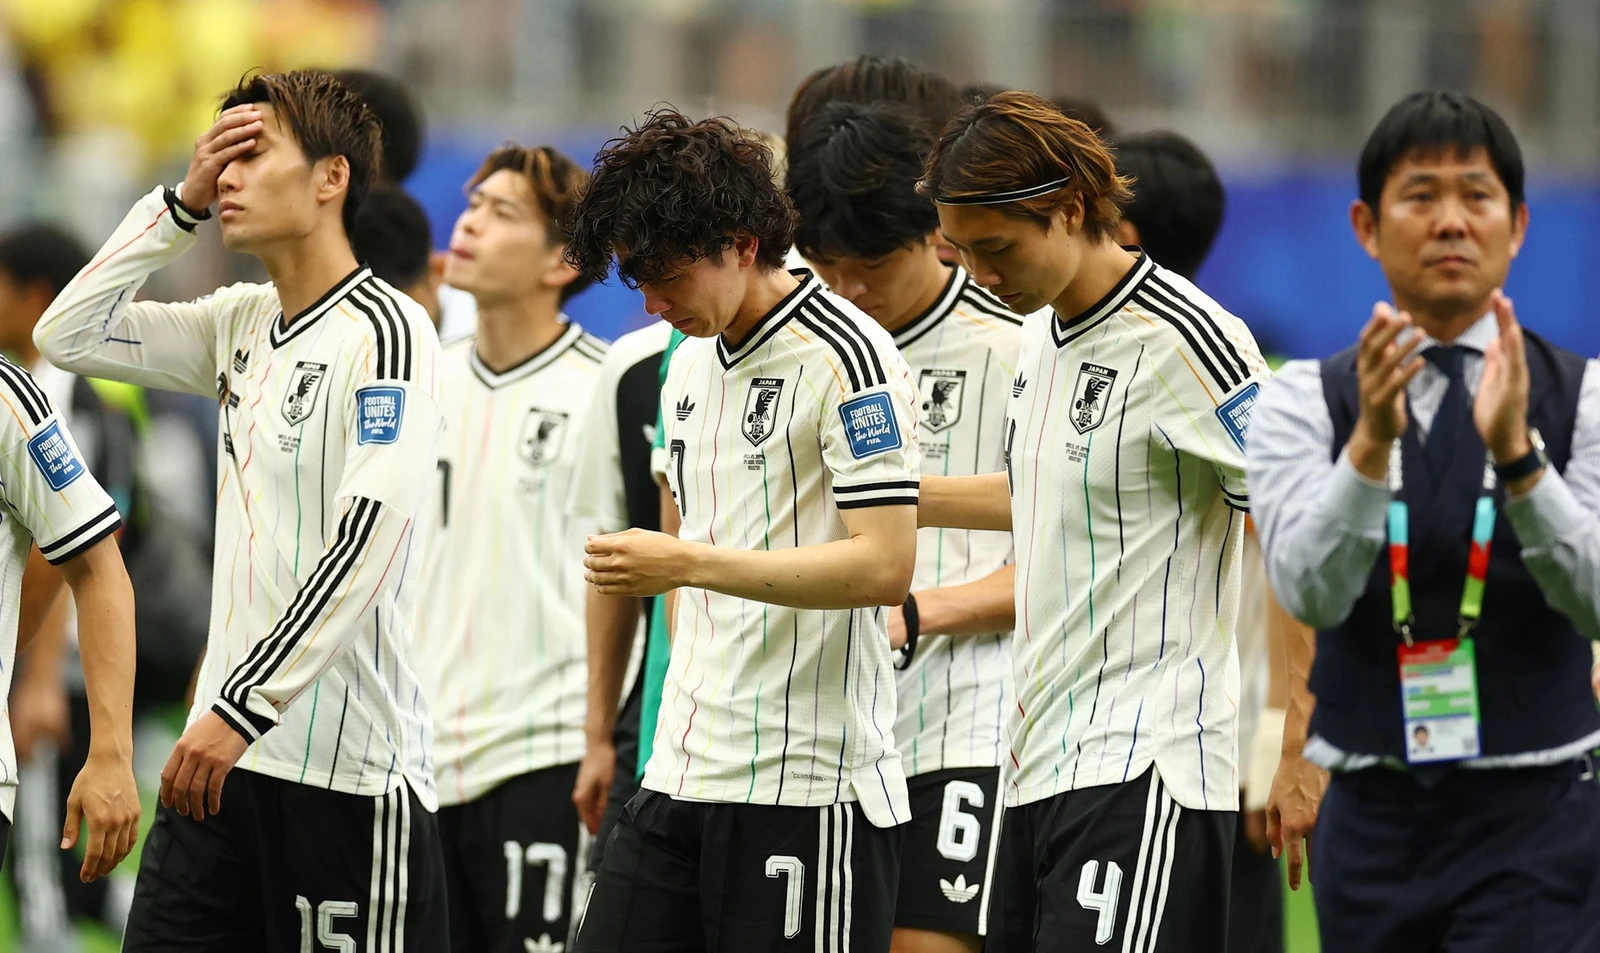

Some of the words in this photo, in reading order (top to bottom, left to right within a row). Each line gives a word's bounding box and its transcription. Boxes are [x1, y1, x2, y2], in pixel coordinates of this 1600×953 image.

[302, 362, 320, 370] JAPAN
[1087, 365, 1108, 376] JAPAN
[364, 395, 396, 406] FOOTBALL
[364, 405, 396, 418] UNITES
[850, 402, 884, 420] FOOTBALL
[375, 418, 397, 429] World
[852, 411, 886, 431] UNITES
[854, 430, 868, 442] the
[867, 423, 891, 438] World
[866, 437, 882, 446] FIFA
[936, 779, 986, 863] 6
[503, 839, 567, 923] 17
[765, 855, 805, 940] 7
[1076, 859, 1124, 946] 4
[295, 894, 359, 953] 15
